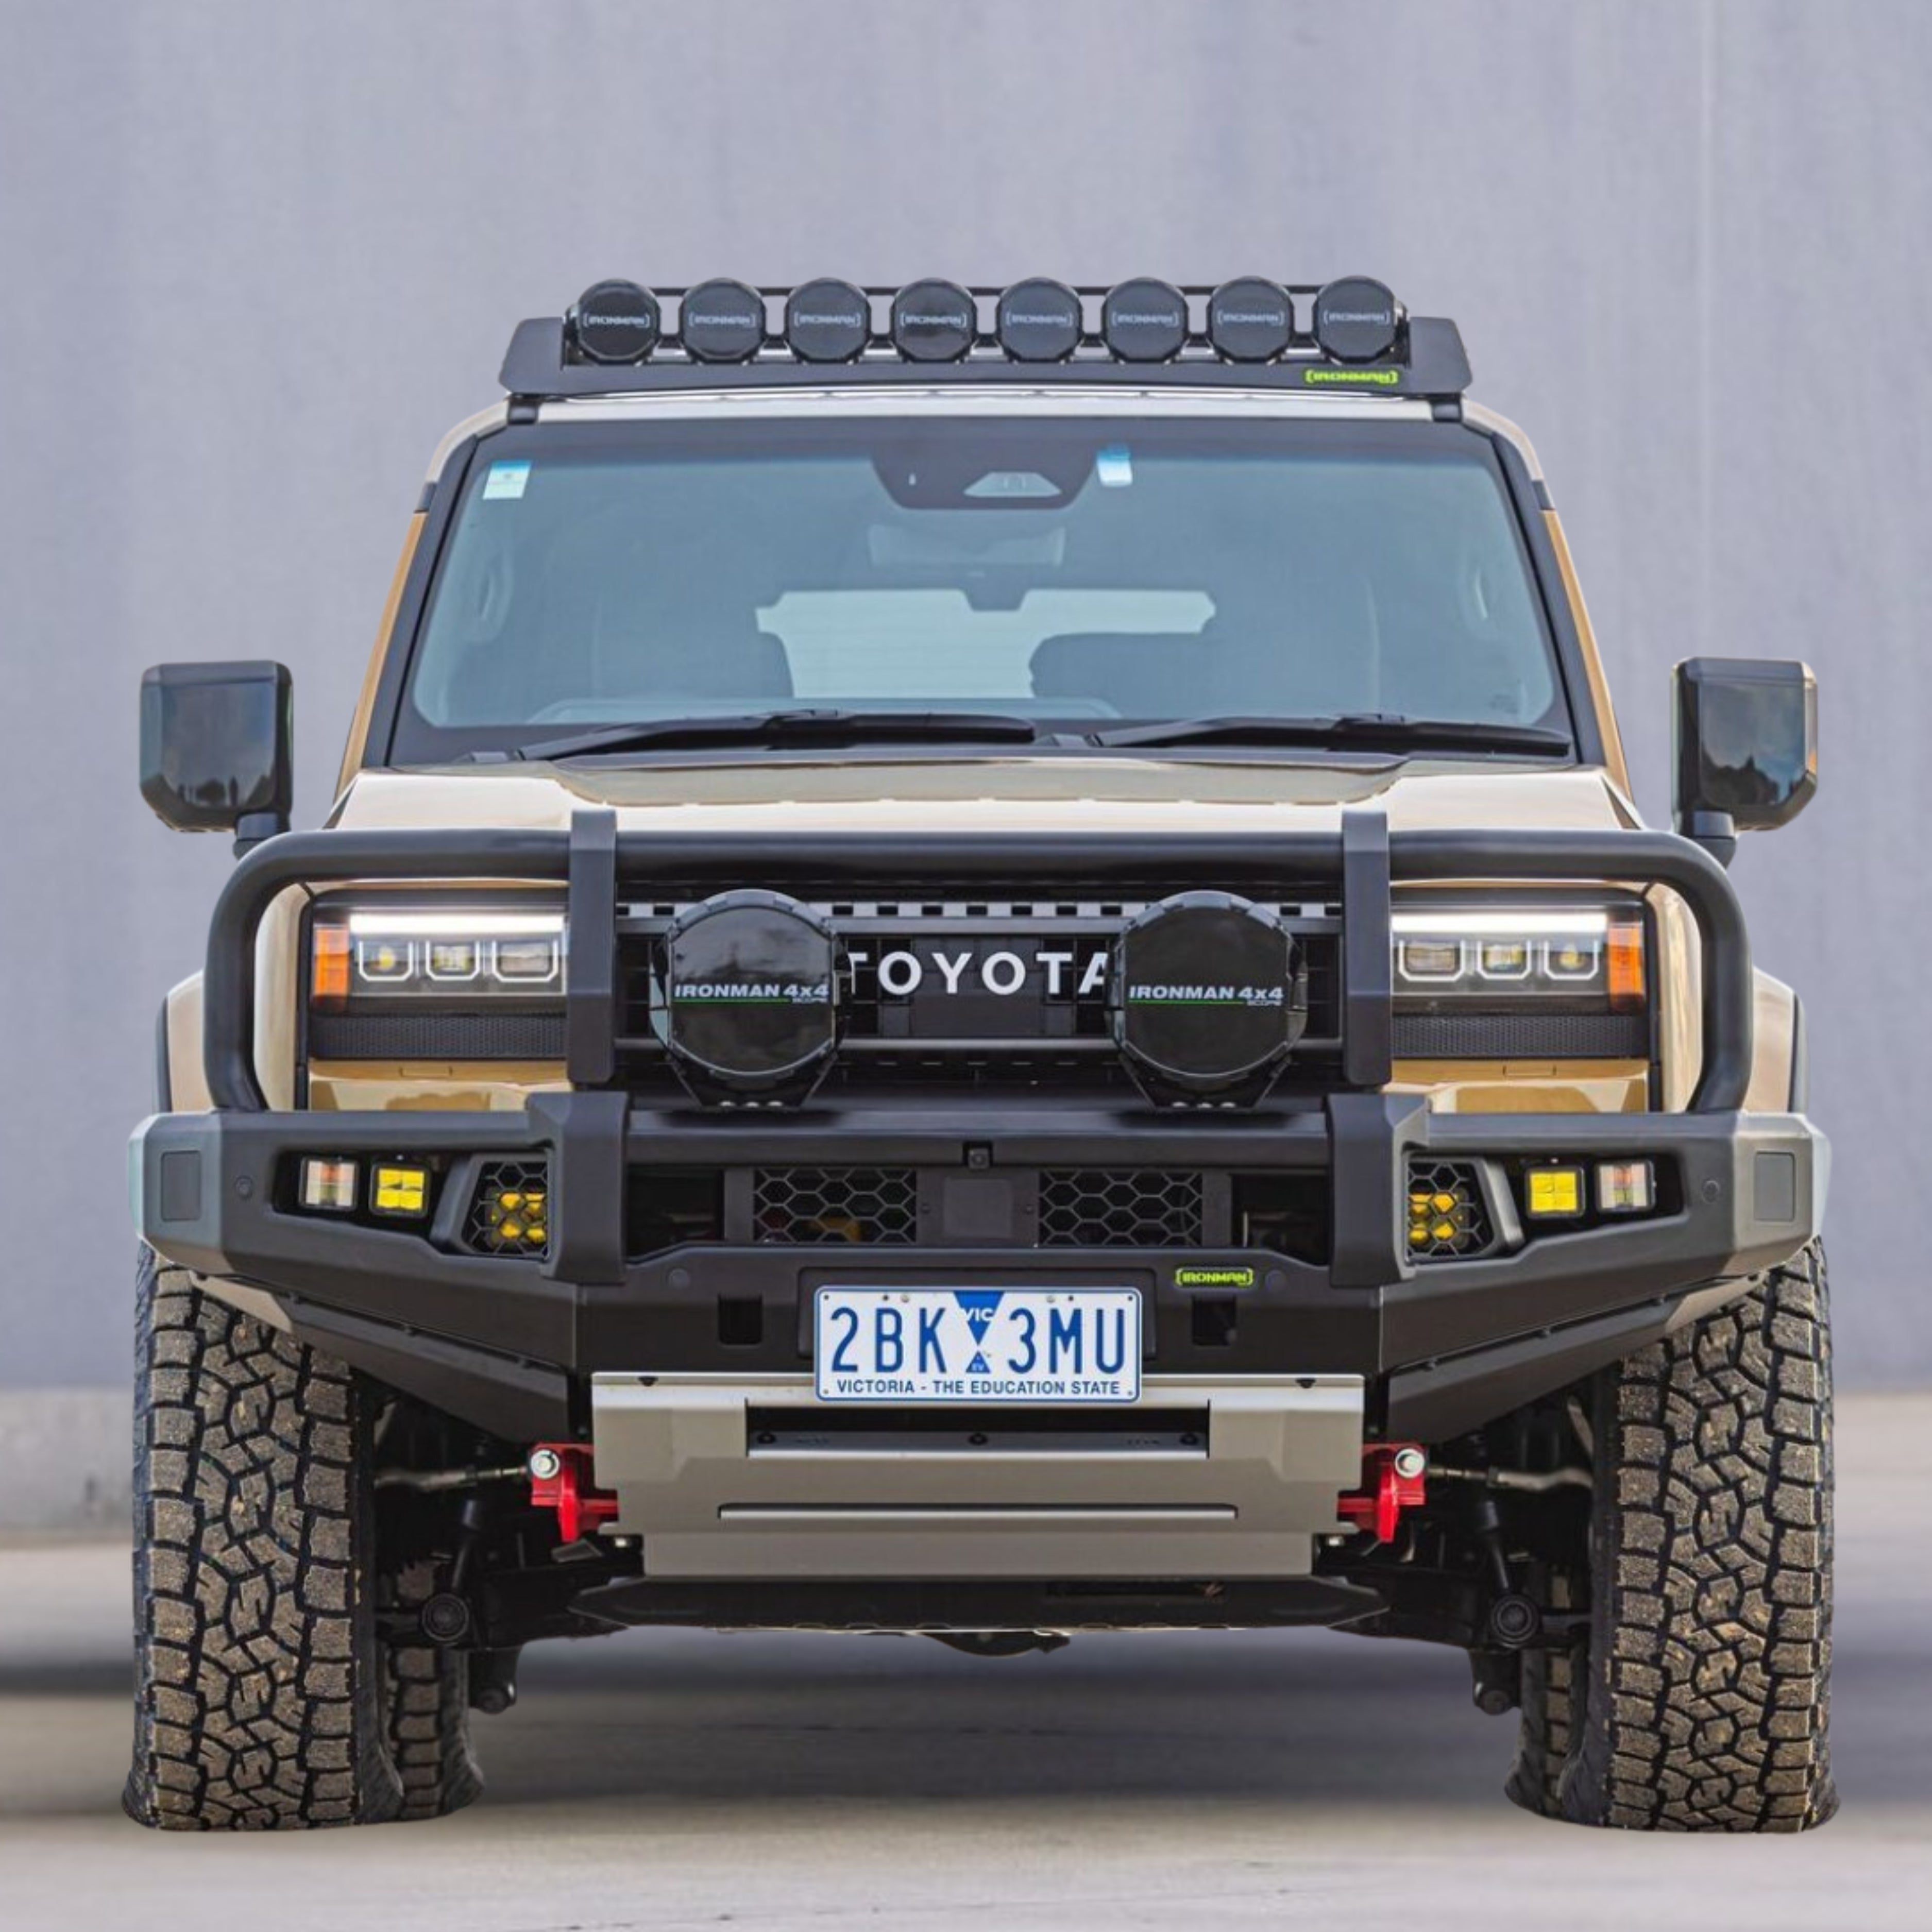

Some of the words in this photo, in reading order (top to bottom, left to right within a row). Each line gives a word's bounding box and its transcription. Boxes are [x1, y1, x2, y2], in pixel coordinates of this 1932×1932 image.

[674, 983, 780, 997] IRONMAN
[782, 983, 829, 997] 4x4
[1129, 985, 1235, 999] IRONMAN
[1237, 986, 1283, 999] 4x4
[1181, 1272, 1247, 1285] IRONMAN
[961, 1307, 994, 1322] VIC
[831, 1307, 947, 1374] 2BK
[1007, 1307, 1125, 1375] 3MU
[837, 1379, 914, 1393] VICTORIA
[933, 1381, 963, 1394] THE
[971, 1381, 1065, 1394] EDUCATION
[1071, 1381, 1120, 1394] STATE
